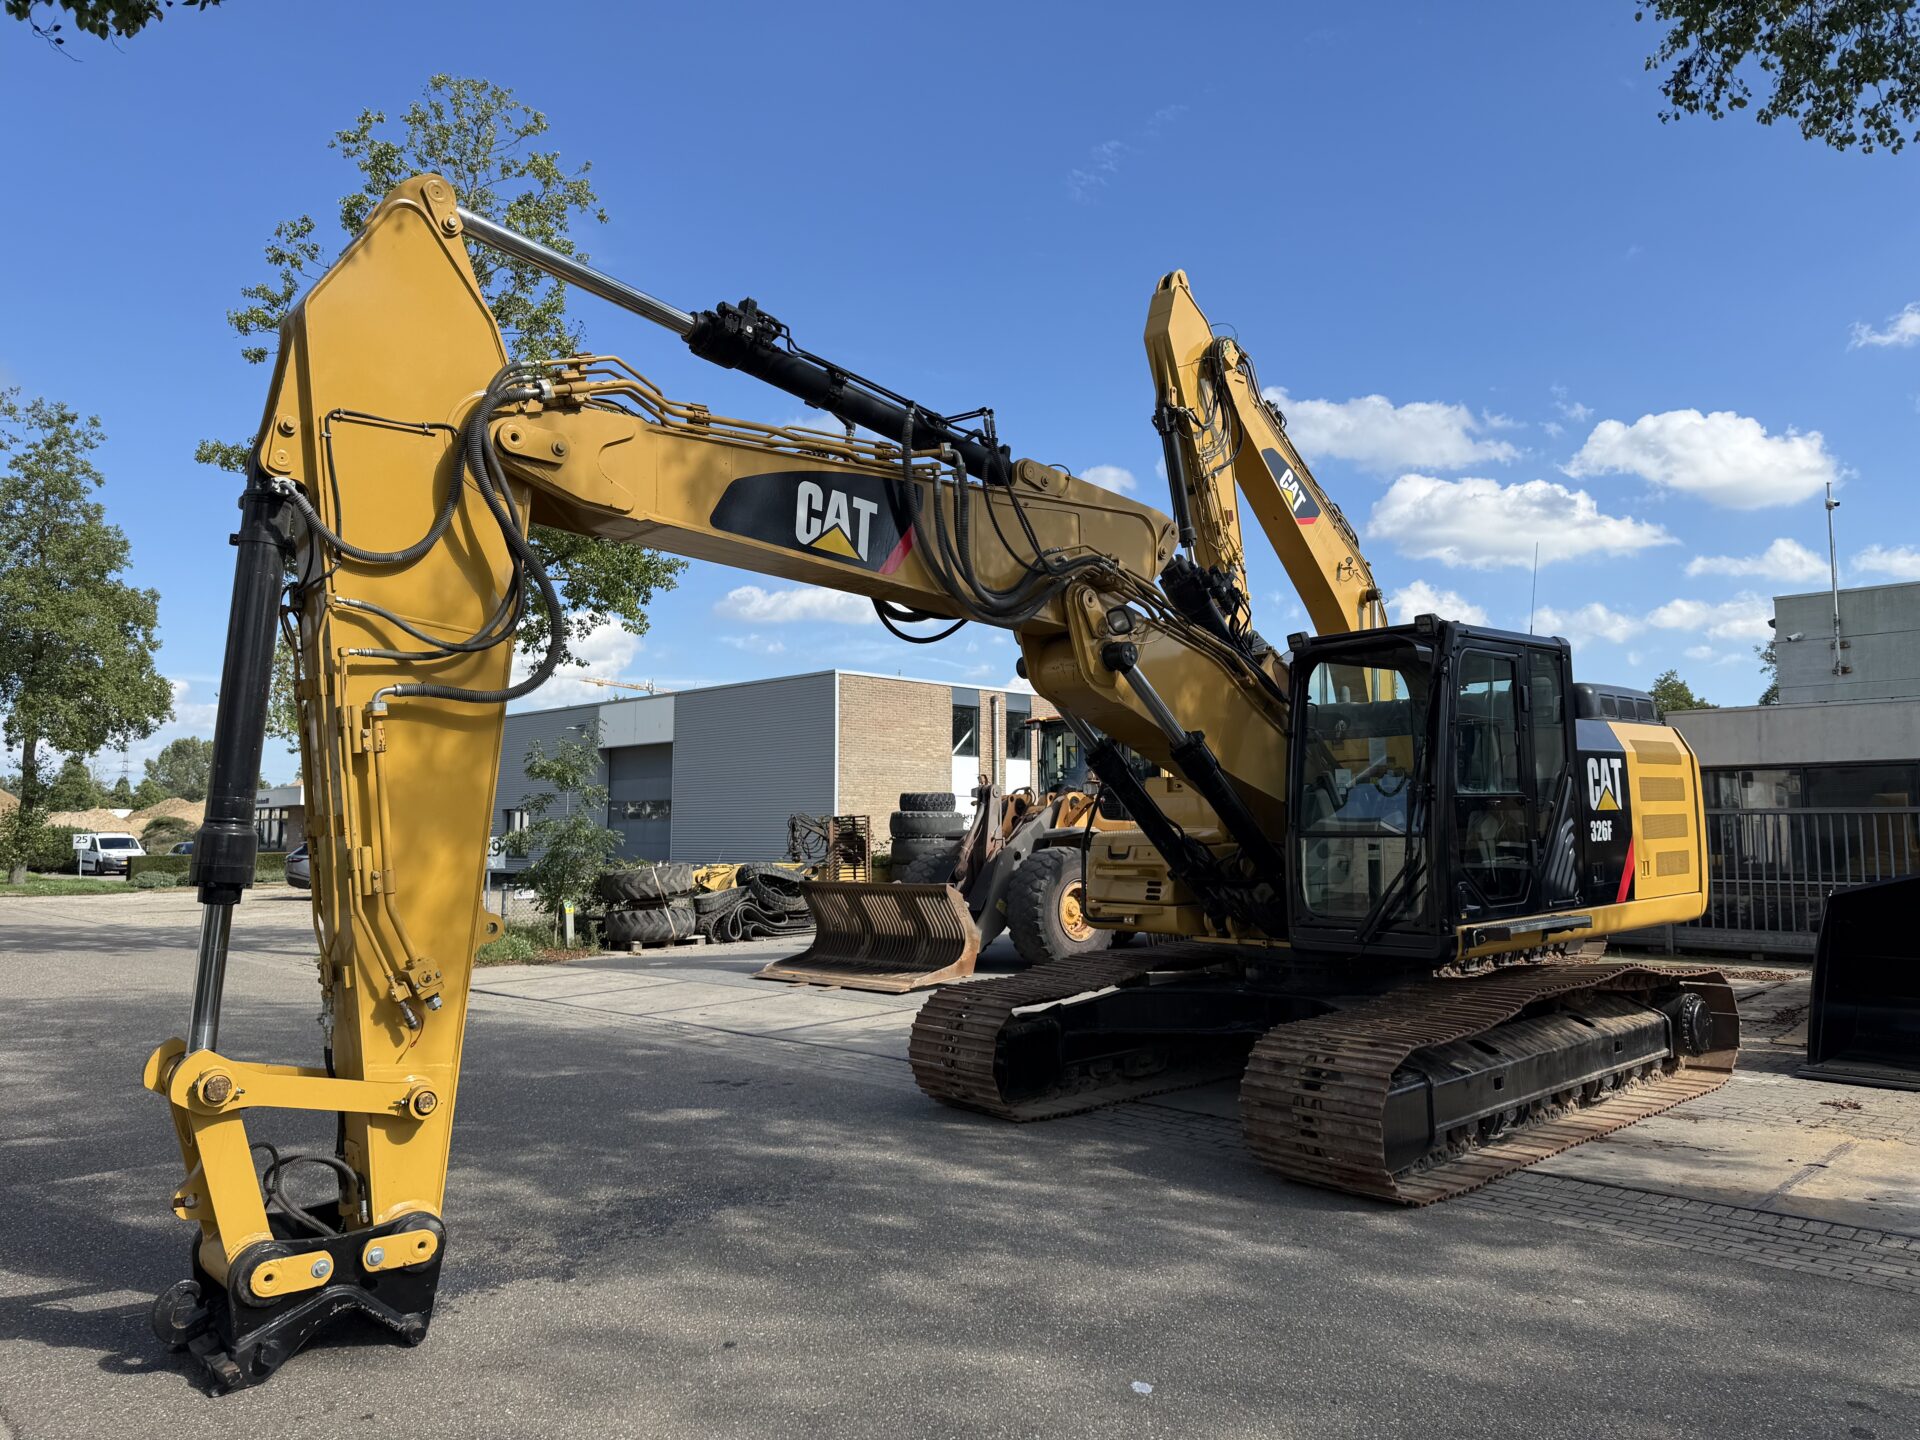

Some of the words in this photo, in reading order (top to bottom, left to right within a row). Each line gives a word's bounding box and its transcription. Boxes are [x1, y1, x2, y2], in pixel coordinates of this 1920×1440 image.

[1280, 468, 1306, 512] CAT
[795, 480, 878, 562] CAT
[1586, 757, 1623, 811] CAT
[75, 835, 88, 844] 25
[1590, 820, 1612, 842] 326F
[487, 840, 501, 857] 9
